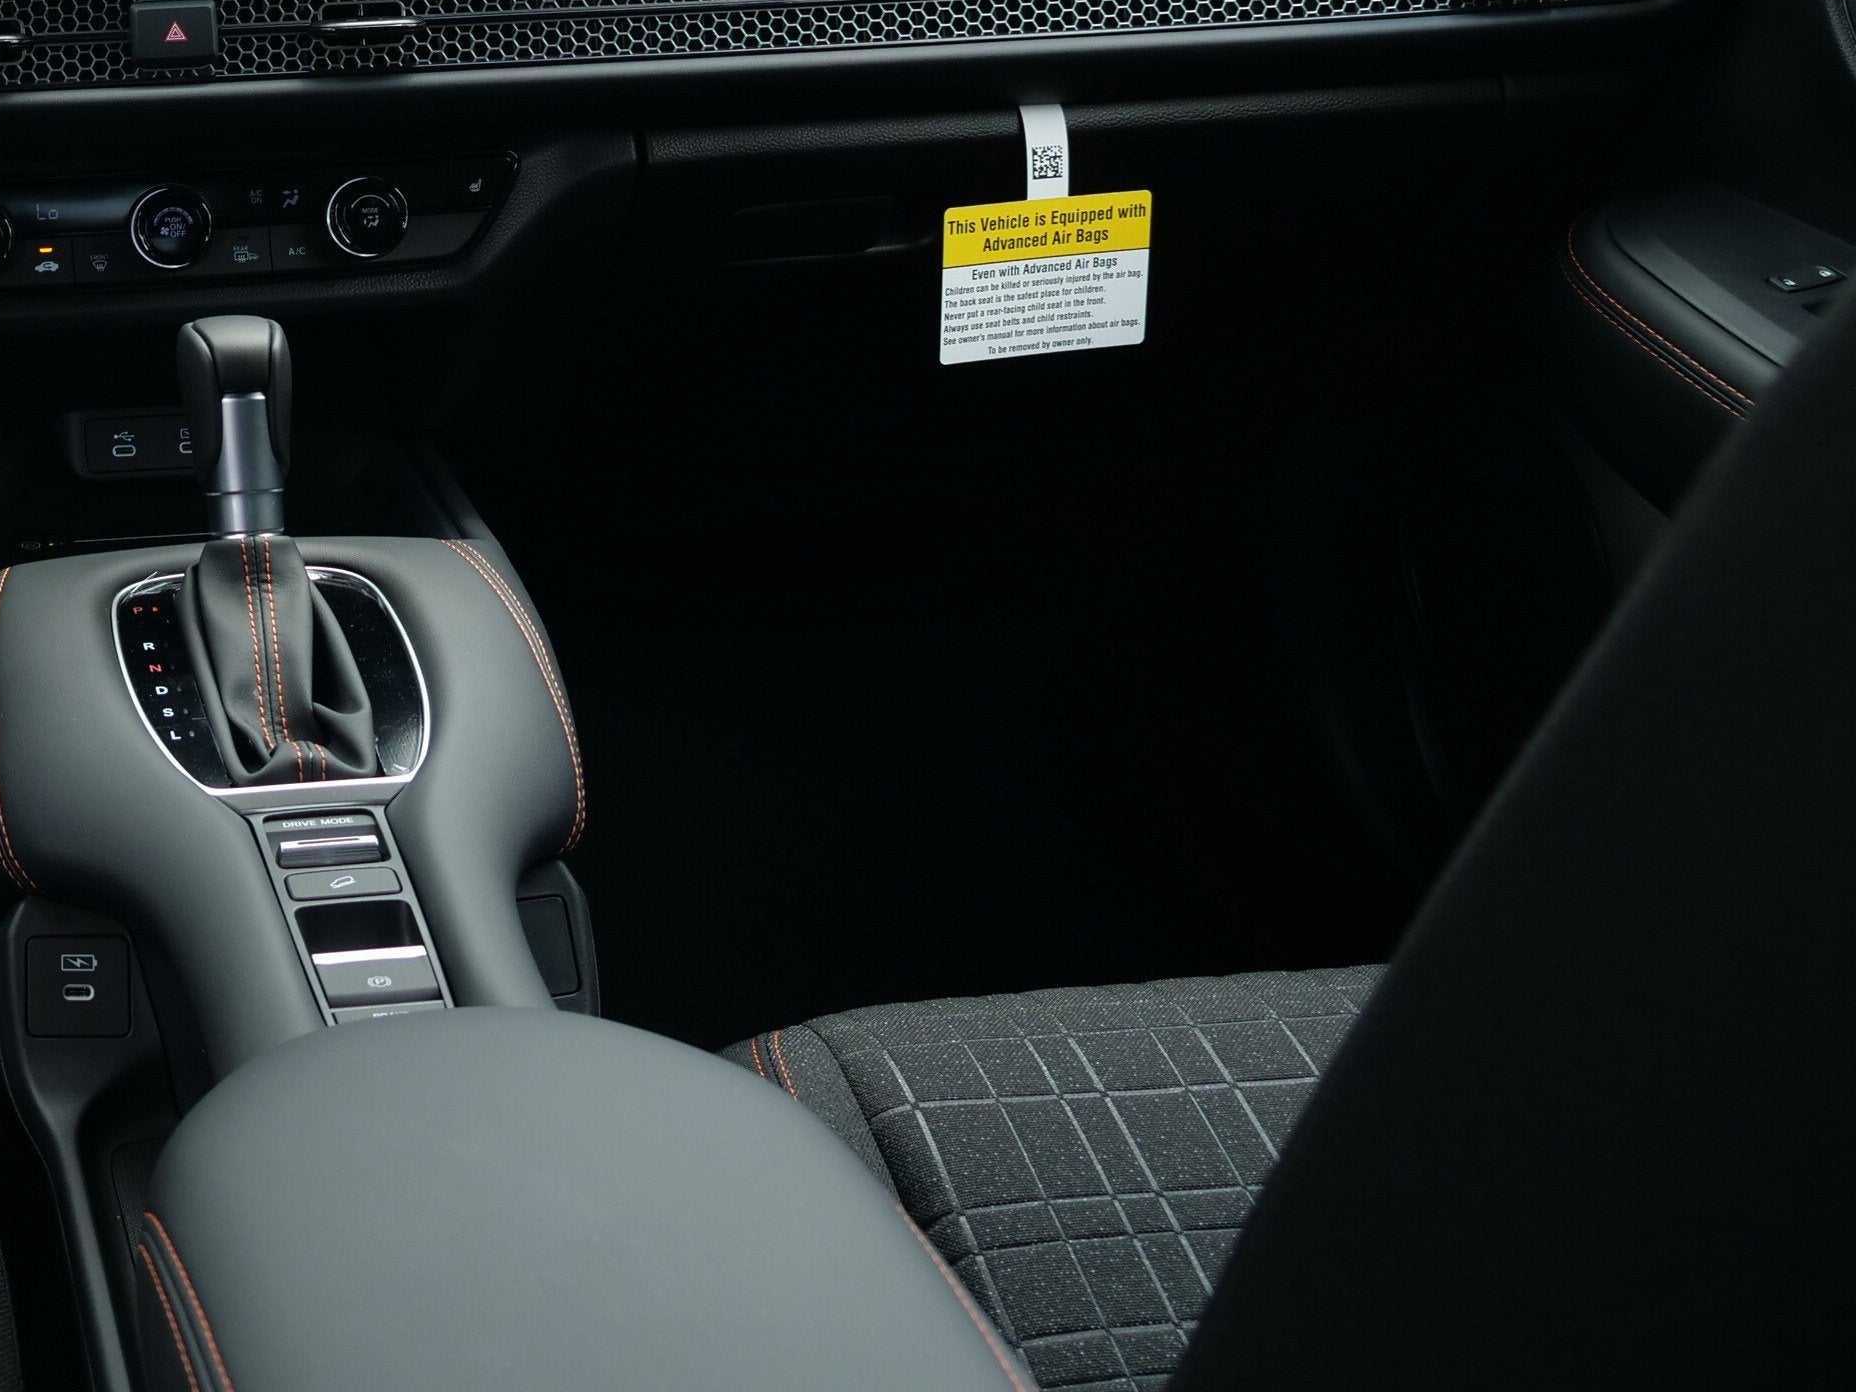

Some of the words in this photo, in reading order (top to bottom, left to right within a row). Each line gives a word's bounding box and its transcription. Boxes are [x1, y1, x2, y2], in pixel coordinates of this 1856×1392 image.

[249, 189, 263, 197] A/C
[948, 219, 976, 235] This
[980, 213, 1030, 232] Vehicle
[1034, 212, 1046, 227] is
[1051, 206, 1113, 227] Equipped
[1118, 203, 1146, 219] with
[170, 229, 186, 237] OFF
[983, 232, 1047, 252] Advanced
[1052, 230, 1071, 245] Air
[1076, 228, 1109, 245] Bags
[288, 247, 306, 256] A/C
[972, 268, 996, 280] Even
[999, 265, 1020, 277] with
[1023, 260, 1072, 275] Advanced
[1074, 258, 1090, 270] Air
[1093, 257, 1118, 269] Bags
[945, 286, 975, 297] Children
[976, 284, 989, 293] can
[990, 282, 999, 291] be
[1001, 280, 1021, 289] killed
[1022, 280, 1030, 288] or
[1031, 275, 1064, 287] seriously
[1066, 273, 1091, 284] injured
[1093, 272, 1101, 282] by
[1103, 271, 1114, 280] the
[1116, 269, 1126, 278] air
[1127, 269, 1143, 278] bag.
[945, 300, 958, 309] The
[960, 298, 976, 307] back
[978, 296, 994, 305] seat
[1004, 293, 1015, 302] the
[1017, 291, 1039, 300] safest
[1040, 289, 1060, 299] place
[1062, 287, 1072, 296] for
[1074, 285, 1106, 295] children.
[945, 313, 965, 321] Never
[967, 311, 978, 320] put
[987, 305, 1025, 317] rear-facing
[1027, 302, 1045, 312] child
[1047, 300, 1063, 310] seat
[1064, 299, 1071, 307] in
[1073, 298, 1085, 307] the
[1087, 296, 1106, 306] front.
[944, 324, 969, 334] Always
[971, 323, 983, 331] use
[985, 320, 1001, 329] seat
[1002, 318, 1020, 327] belts
[1022, 315, 1035, 325] and
[1037, 313, 1055, 323] child
[1056, 309, 1093, 320] restraints.
[943, 337, 956, 346] See
[958, 333, 985, 344] owner's
[987, 330, 1013, 340] manual
[1015, 328, 1025, 337] for
[1027, 327, 1044, 336] more
[1046, 322, 1086, 334] information
[1088, 320, 1108, 330] about
[1109, 319, 1119, 328] air
[1121, 318, 1141, 327] bags.
[989, 346, 996, 355] To
[998, 344, 1007, 353] be
[1009, 341, 1040, 352] removed
[1042, 340, 1050, 349] by
[1052, 338, 1074, 348] owner
[1076, 336, 1094, 346] only.
[143, 642, 155, 650] R
[149, 664, 162, 673] N
[155, 686, 168, 695] D
[162, 708, 174, 717] S
[170, 730, 182, 740] L
[282, 819, 317, 829] DRIVE
[320, 816, 354, 827] MODE
